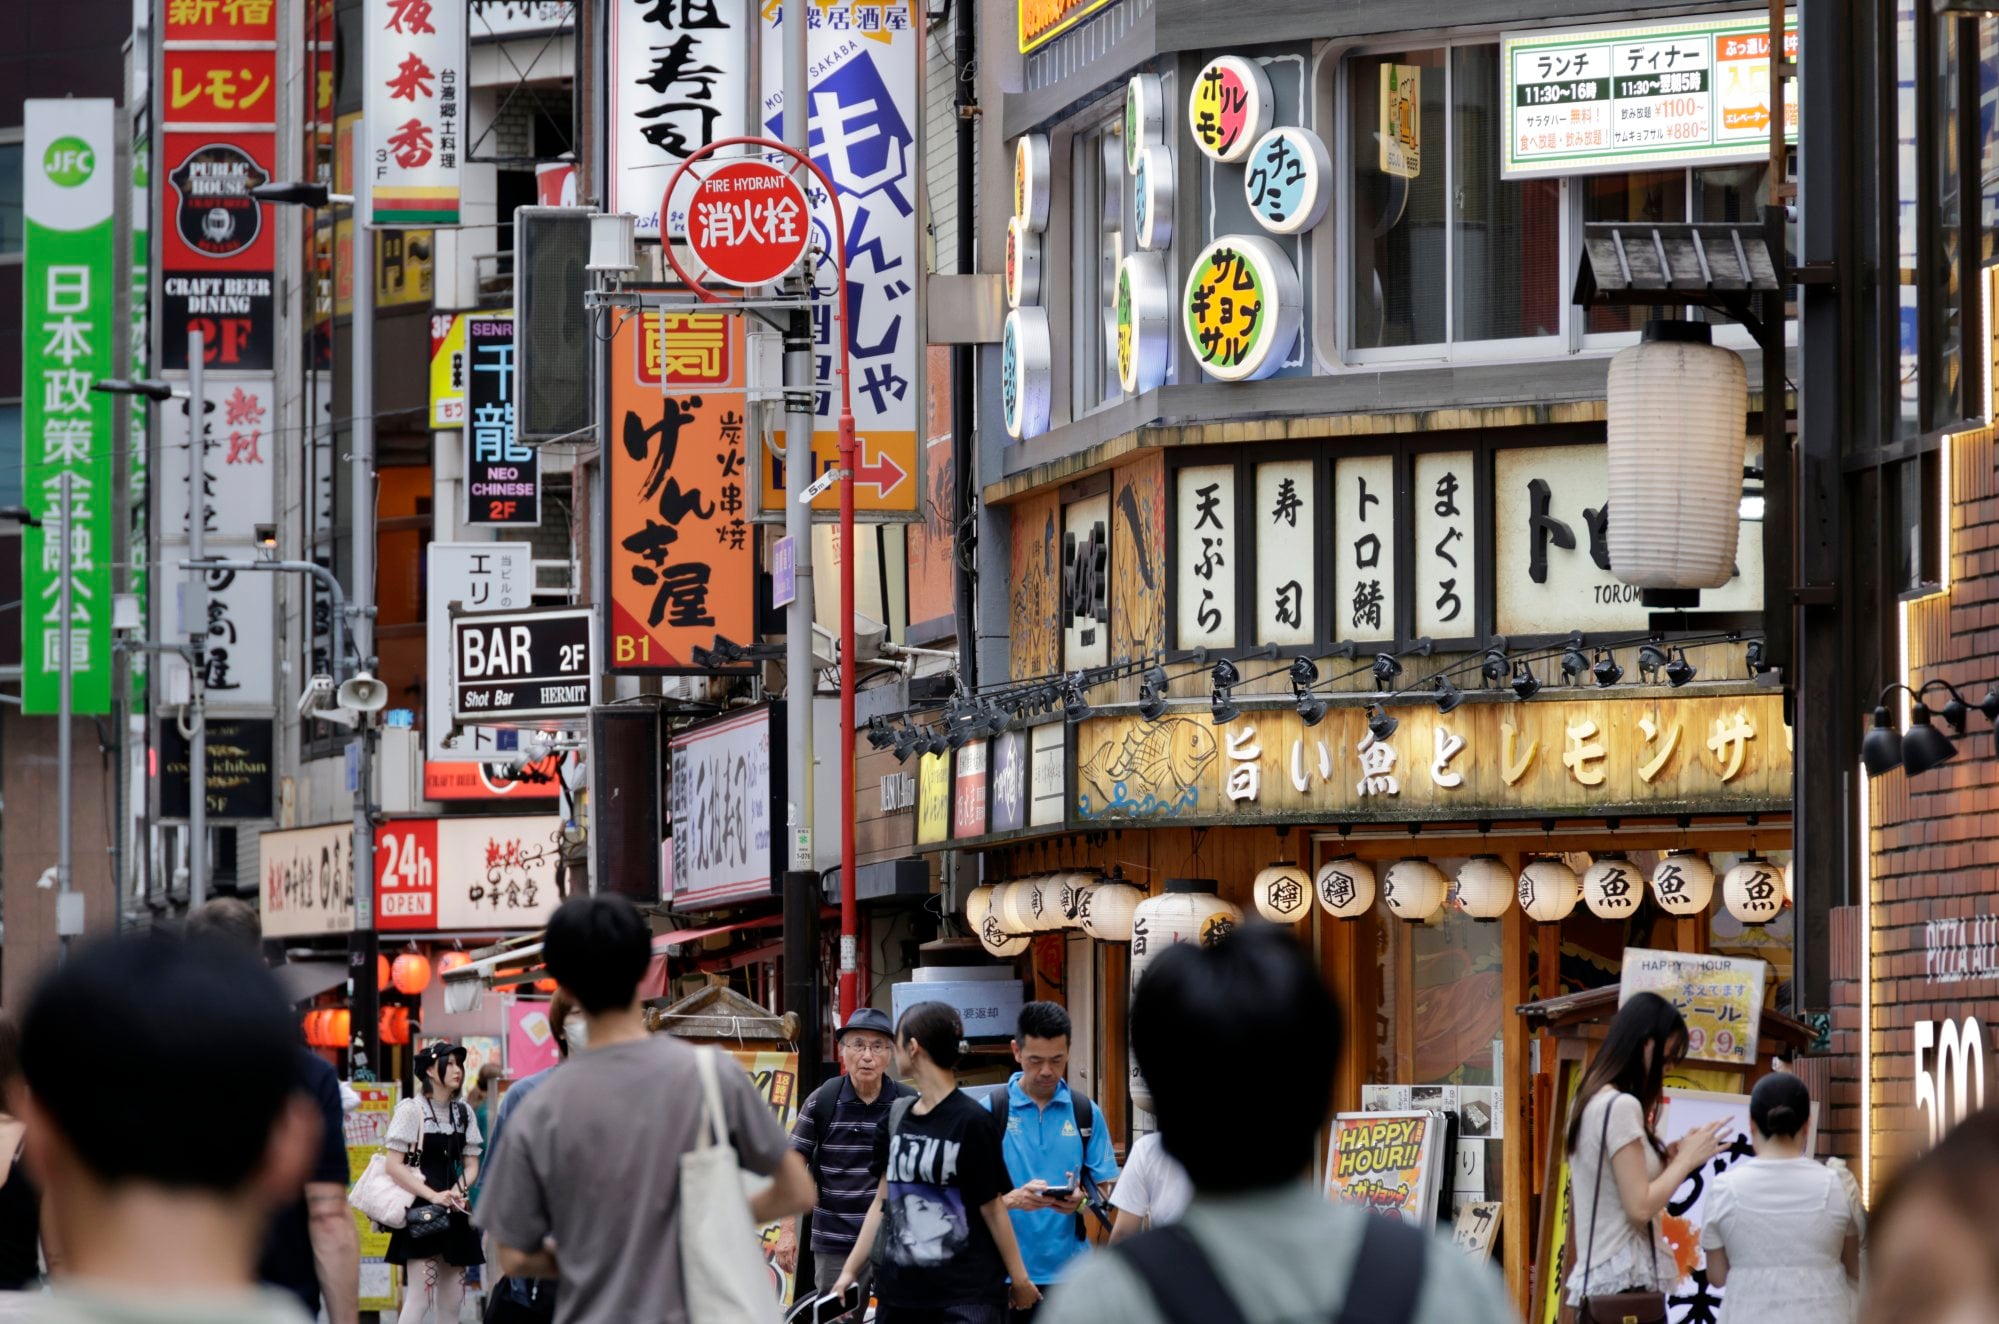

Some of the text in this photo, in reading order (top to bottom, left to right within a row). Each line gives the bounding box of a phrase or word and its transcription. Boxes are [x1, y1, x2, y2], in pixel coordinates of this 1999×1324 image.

[809, 39, 858, 78] SAKABA
[1537, 52, 1590, 79] ランチ
[1627, 45, 1700, 72] ディナー
[171, 67, 270, 110] レモン
[439, 68, 457, 169] 台湾郷土料理
[1196, 66, 1249, 157] ホルモン
[1621, 106, 1652, 120] 飲み放題
[46, 150, 93, 175] JFC
[188, 162, 249, 179] PUBLIC
[191, 180, 246, 196] HOUSE
[705, 175, 786, 193] FIRE HYDRANT
[697, 196, 801, 248] 消火栓
[165, 278, 271, 296] CRAFT BEER
[187, 296, 250, 314] DINING
[472, 323, 513, 336] SENR
[488, 467, 518, 481] NEO
[716, 411, 746, 551] 炭火串焼
[472, 483, 534, 497] CHINESE
[489, 502, 516, 520] 2F
[1193, 482, 1226, 634] 天ぷら
[1271, 477, 1304, 630] 寿司
[1351, 475, 1385, 631] トロ鯖
[1434, 471, 1464, 623] まぐろ
[1593, 584, 1643, 604] TOROM
[462, 625, 586, 678] BAR 2F
[616, 636, 651, 662] B1
[464, 685, 587, 708] Shot Bar HERMIT
[381, 833, 432, 888] 24h
[1600, 867, 1632, 909] 魚
[1657, 864, 1691, 905] 魚
[1742, 869, 1776, 911] 魚
[386, 896, 426, 914] OPEN
[1926, 917, 1969, 984] PIZZA
[1642, 960, 1732, 972] HAPPY HOUR
[1682, 984, 1746, 997] 冷えてます
[1914, 1015, 1985, 1150] 500
[1339, 1120, 1416, 1152] HAPPY
[1338, 1144, 1420, 1178] HOUR!!
